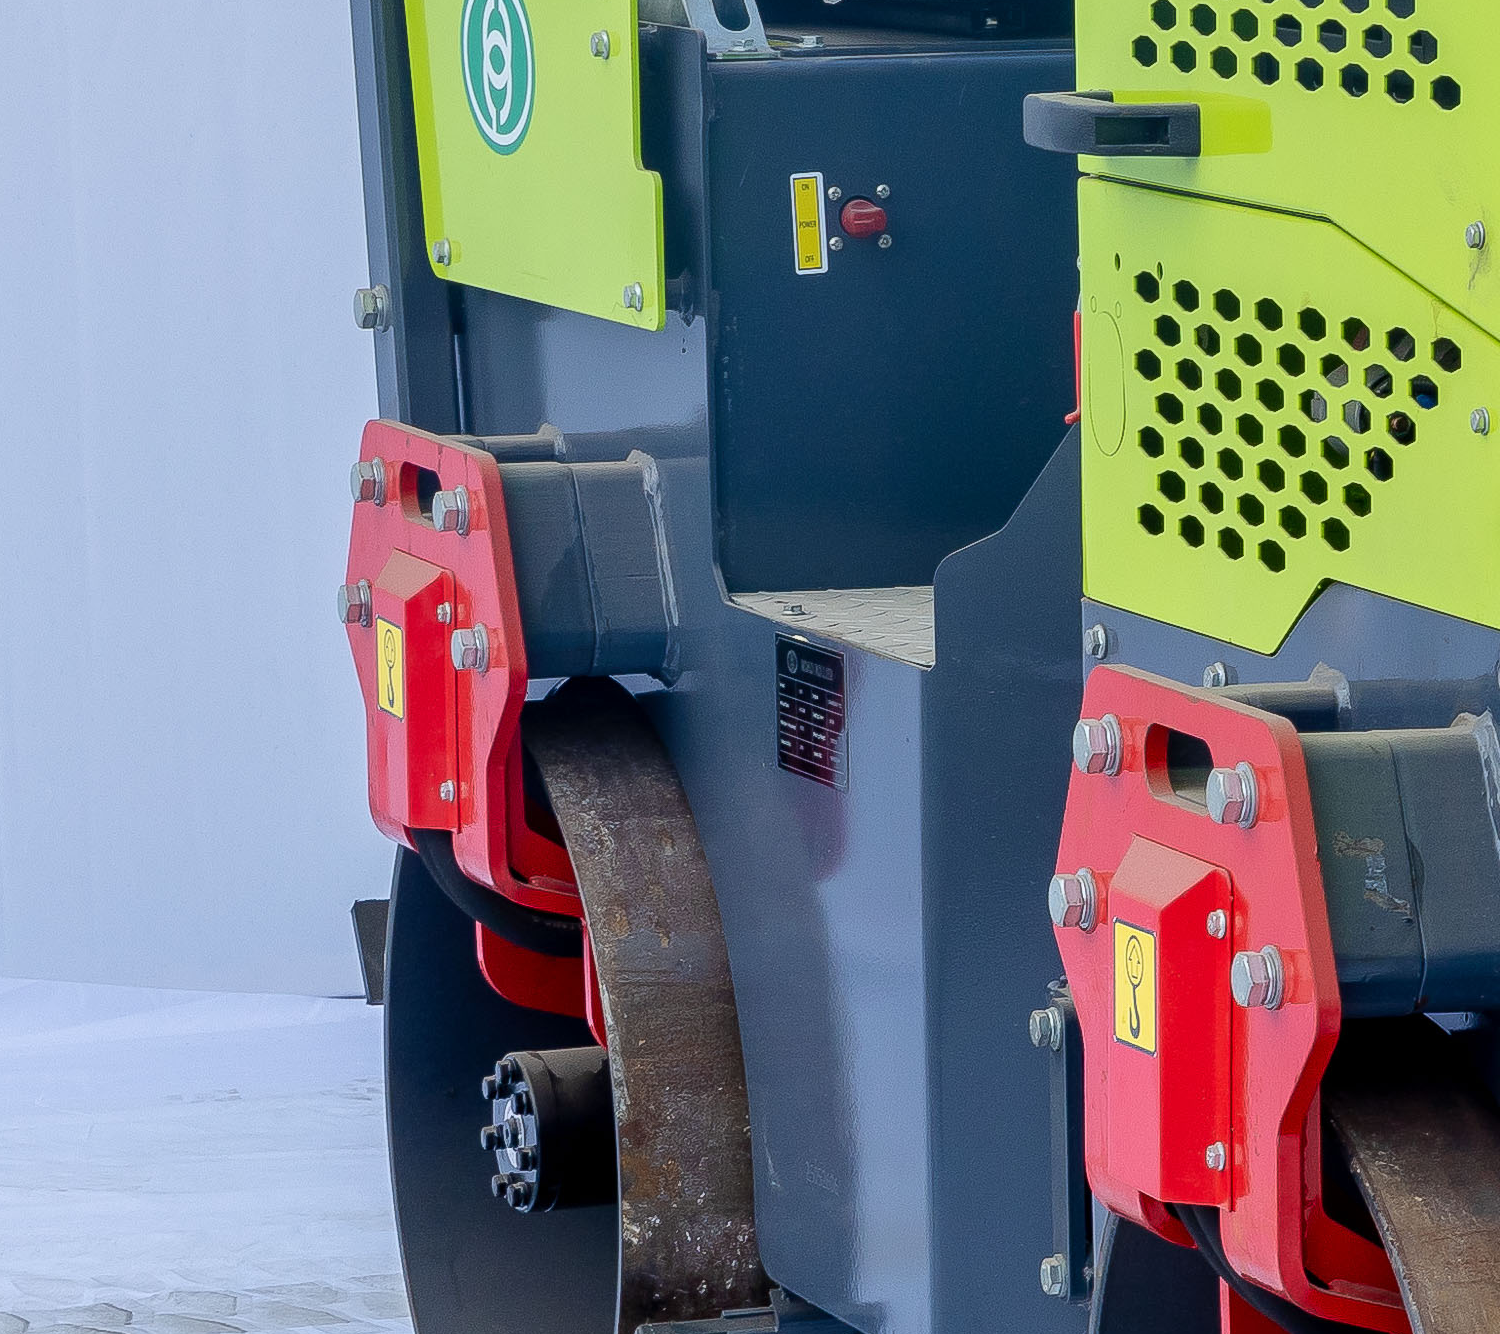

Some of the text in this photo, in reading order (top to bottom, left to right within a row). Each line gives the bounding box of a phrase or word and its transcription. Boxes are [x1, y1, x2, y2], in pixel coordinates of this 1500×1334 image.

[801, 183, 810, 191] ON
[798, 220, 816, 228] POWER
[804, 254, 814, 263] OFF
